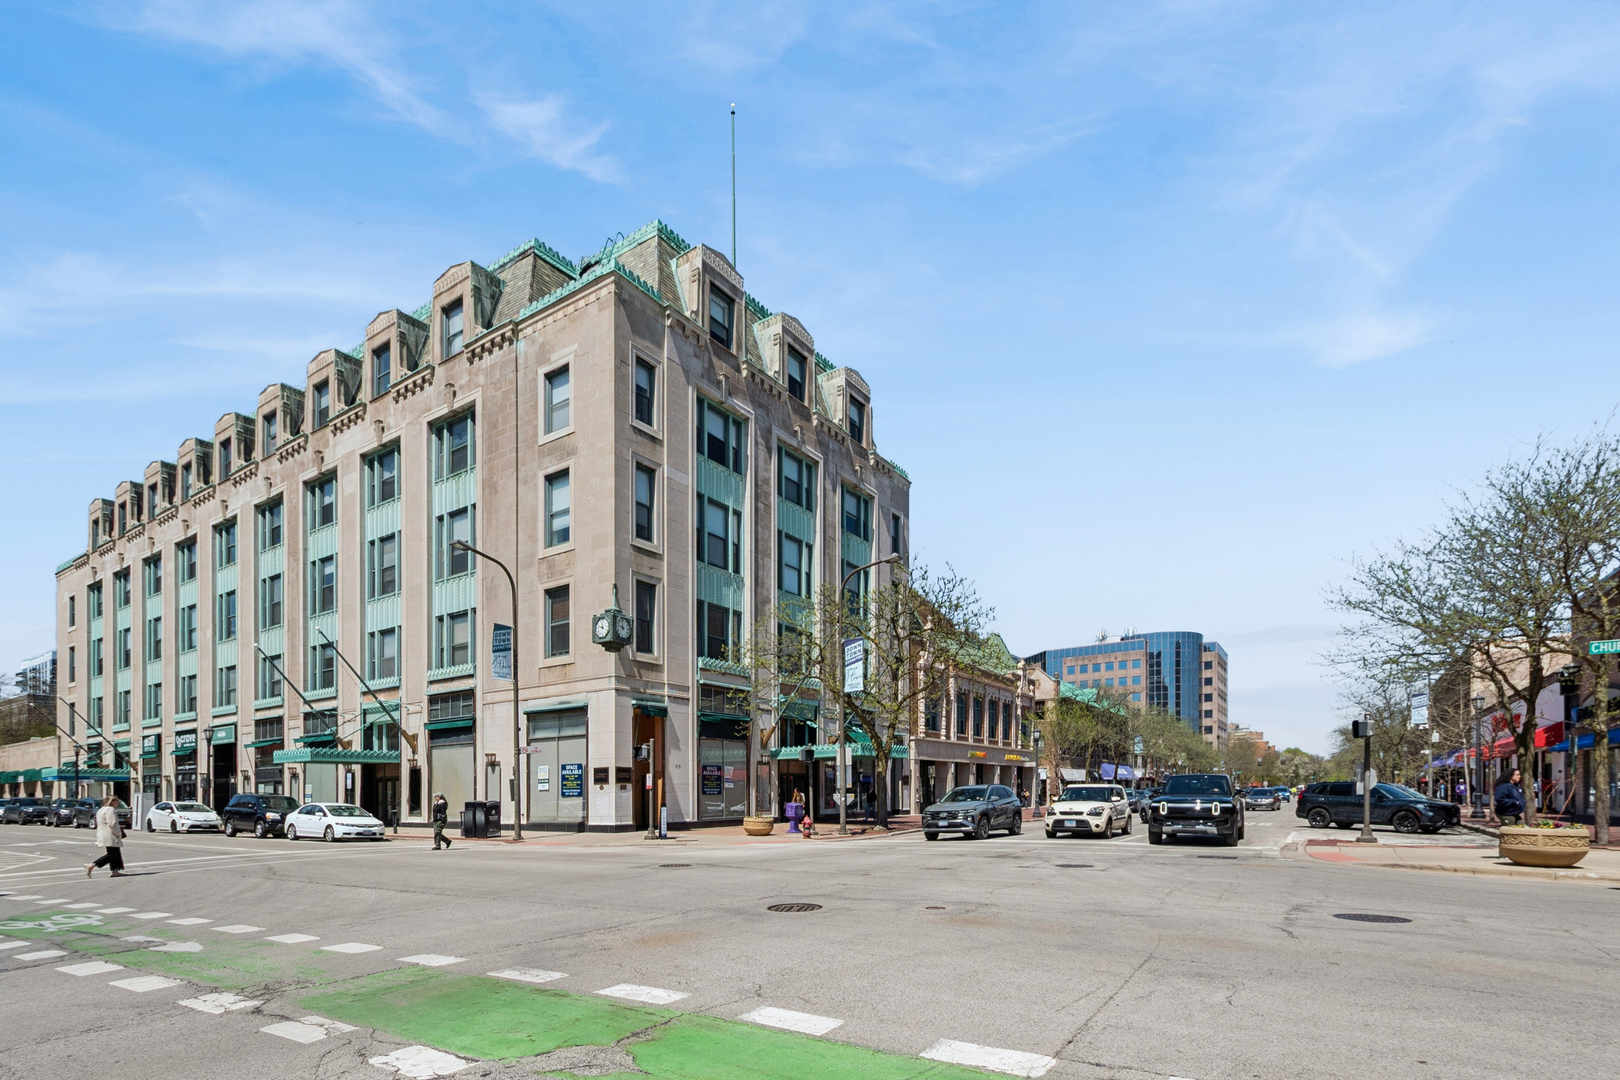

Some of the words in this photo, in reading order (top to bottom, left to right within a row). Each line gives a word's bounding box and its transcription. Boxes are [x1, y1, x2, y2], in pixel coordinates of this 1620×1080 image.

[494, 631, 511, 639] DOWN
[494, 637, 511, 645] TOWN
[846, 643, 862, 653] DOWN
[846, 649, 862, 659] TOWN
[180, 733, 196, 744] crave
